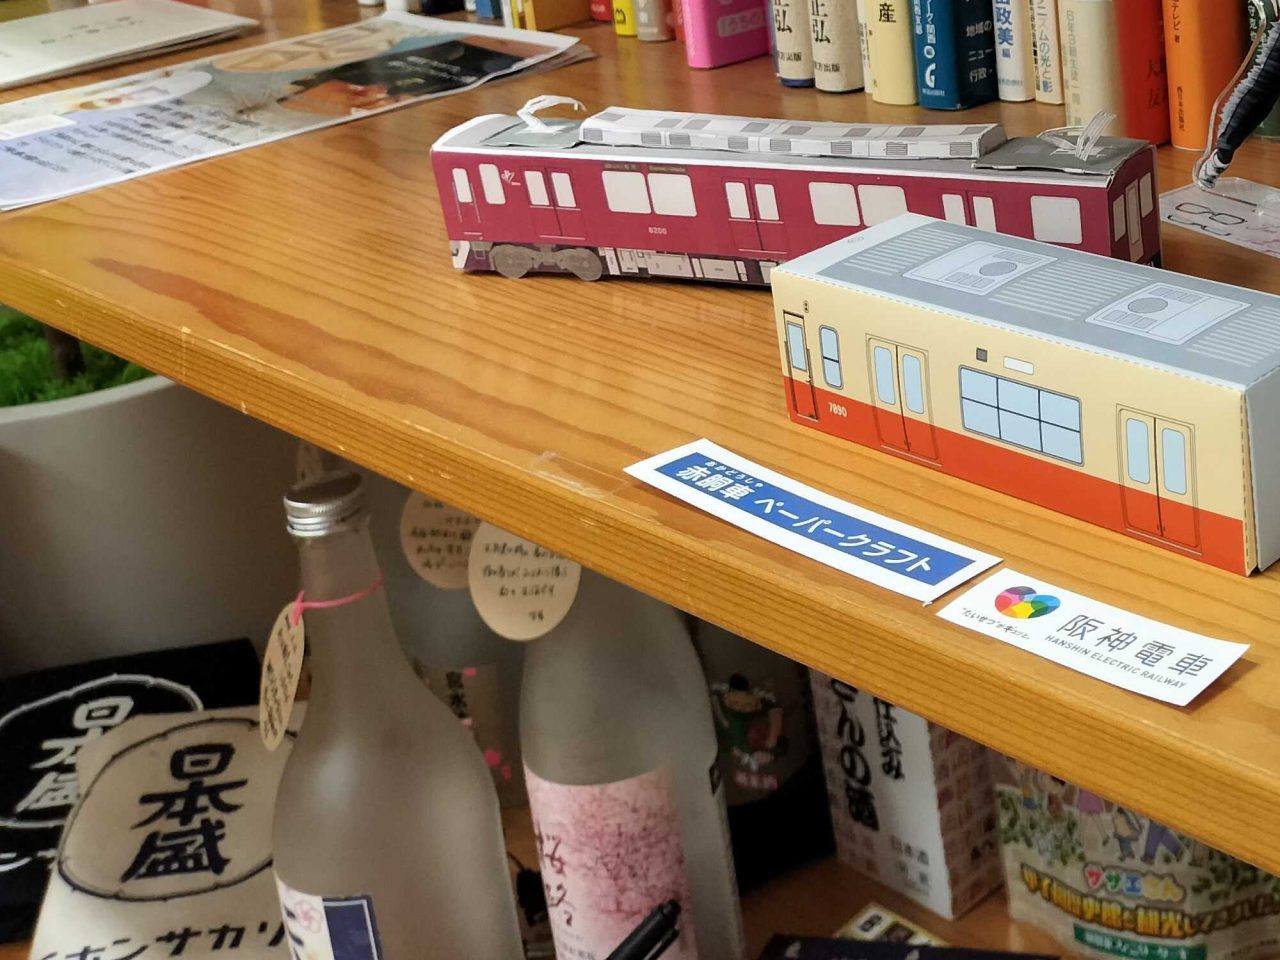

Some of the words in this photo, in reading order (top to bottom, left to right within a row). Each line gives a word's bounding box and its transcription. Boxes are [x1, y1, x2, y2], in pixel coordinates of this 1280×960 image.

[828, 401, 848, 418] 7890
[705, 460, 764, 489] あかどうしゃ
[676, 464, 758, 502] 赤胴車
[754, 496, 934, 575] ペーパークラフト
[1045, 634, 1091, 657] HANSHIN
[1090, 652, 1140, 675] ELECTRIC
[1141, 669, 1188, 690] RAILWAY
[1056, 613, 1214, 677] 阪神電車
[120, 742, 249, 885] 日本盛
